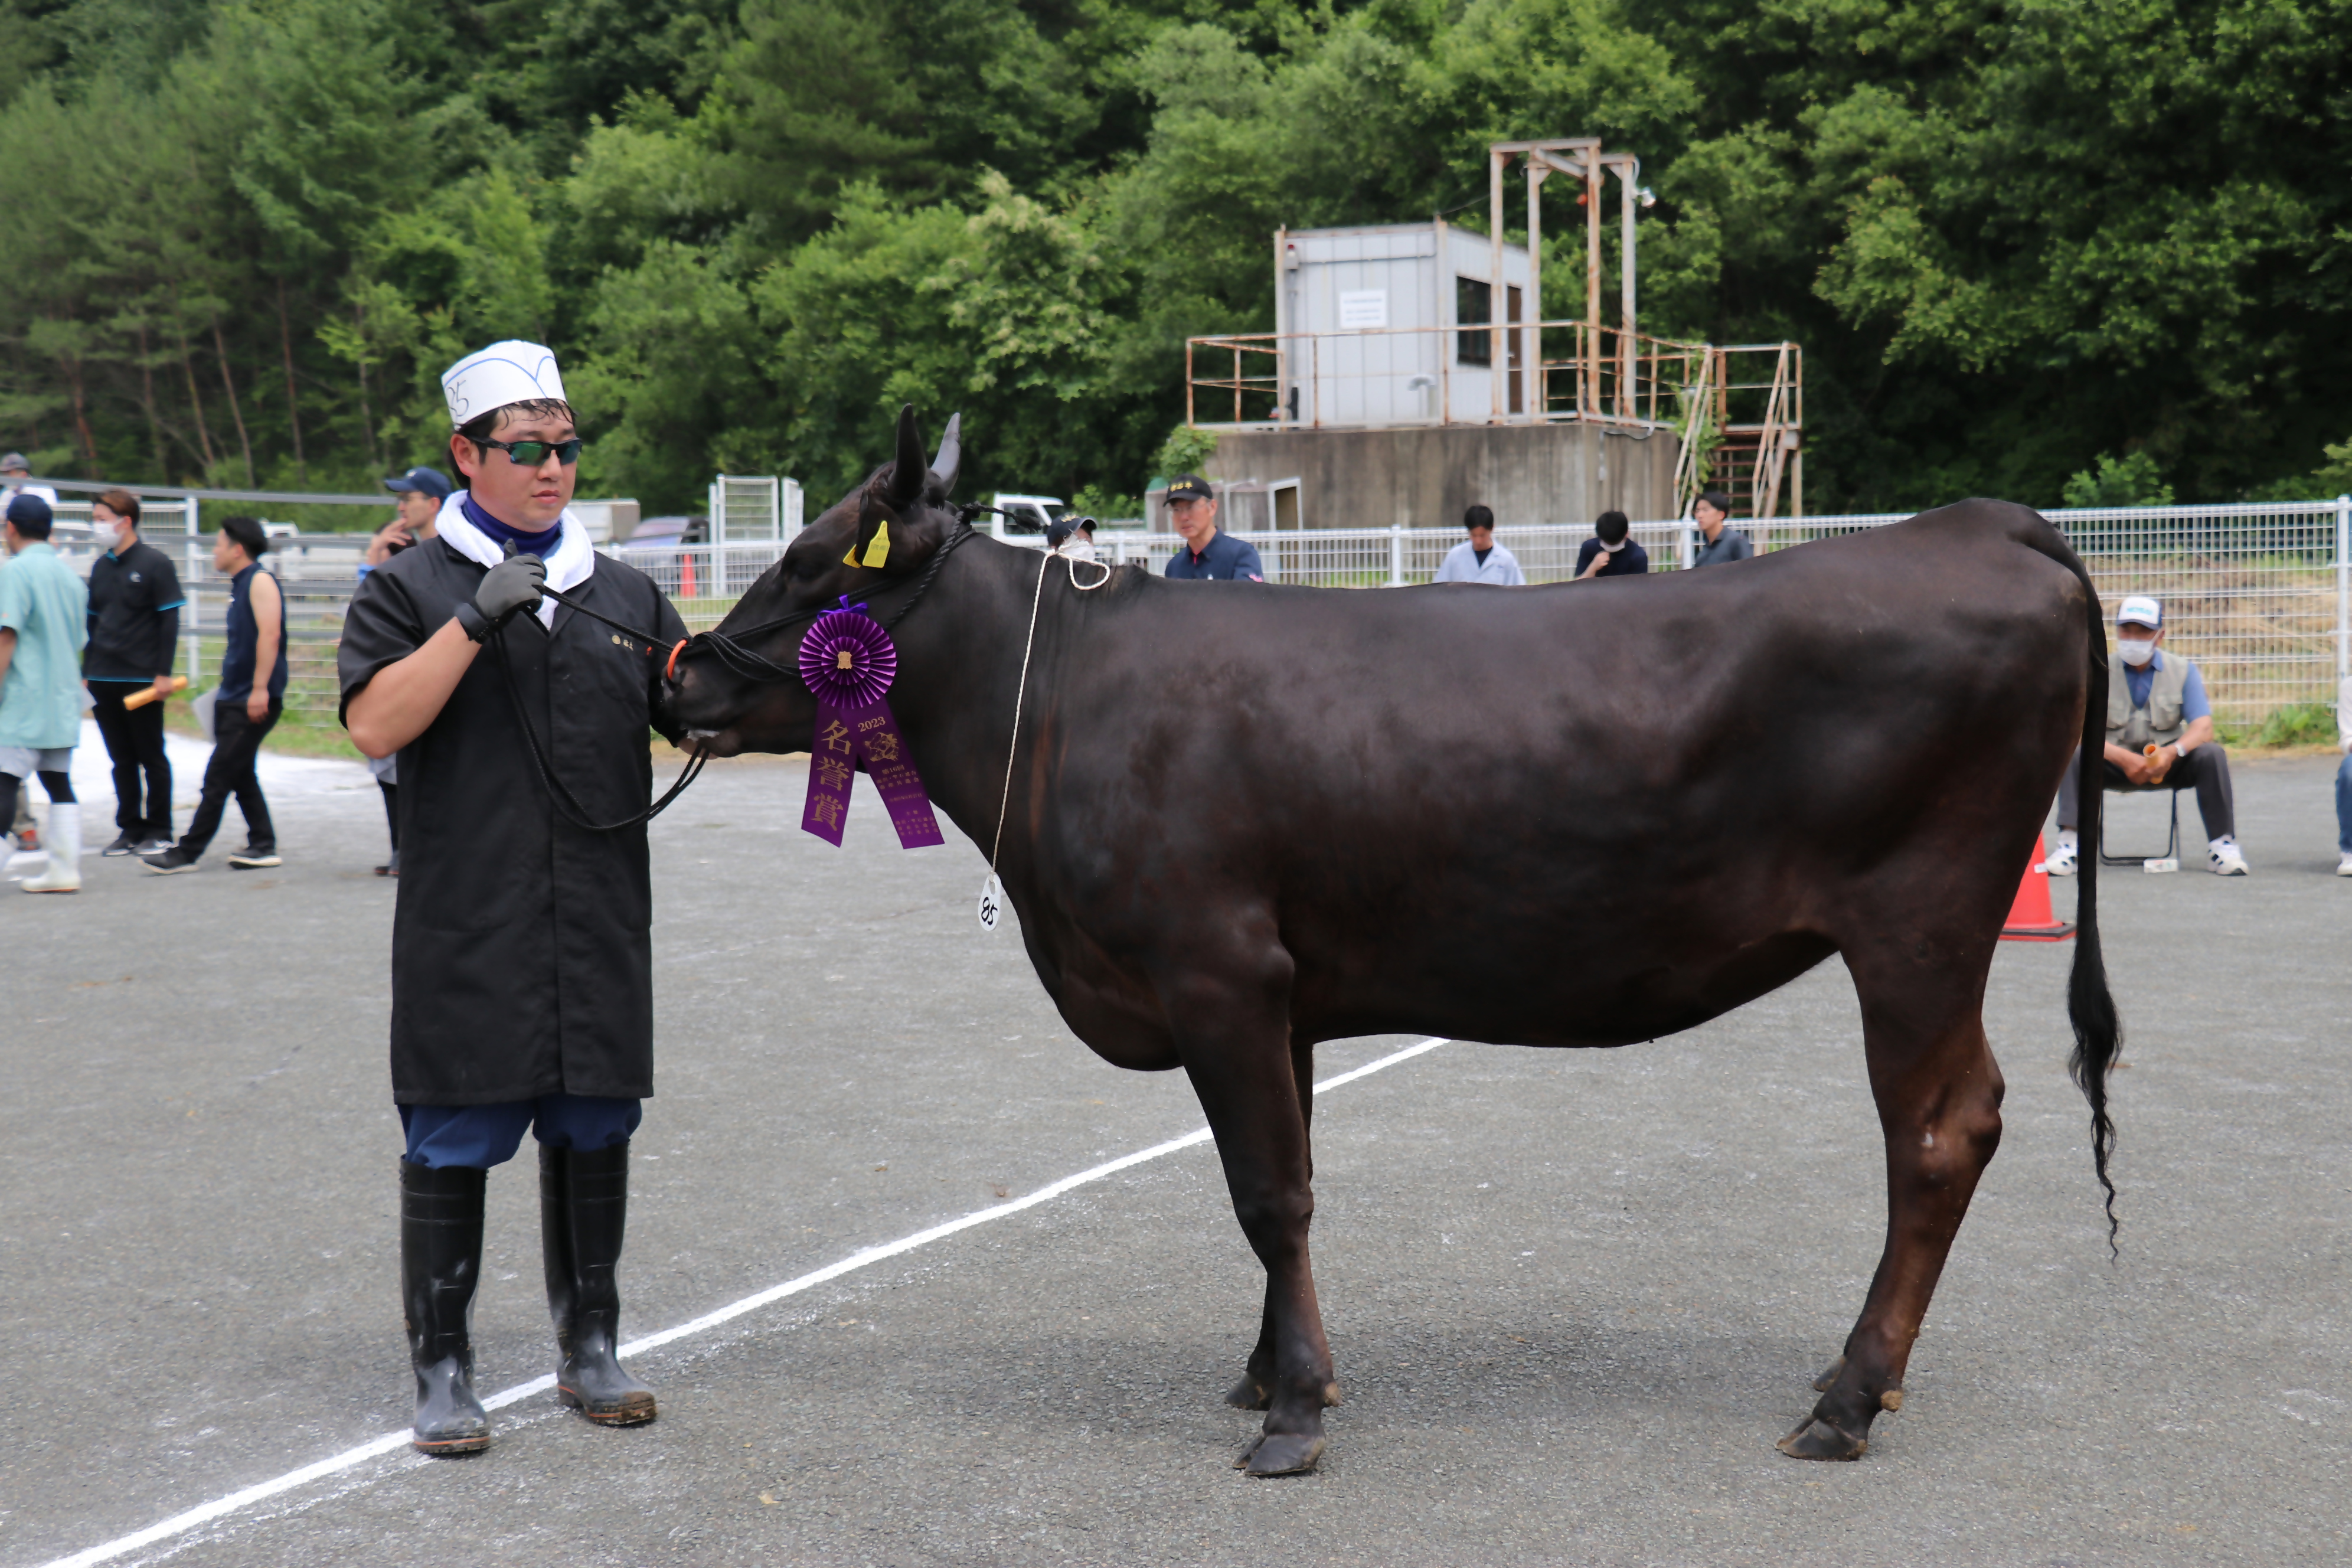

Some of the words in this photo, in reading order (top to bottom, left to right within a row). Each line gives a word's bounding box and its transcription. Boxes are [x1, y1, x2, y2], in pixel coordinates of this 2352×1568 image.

[858, 716, 886, 732] 2023
[811, 719, 852, 831] 名誉賞
[981, 896, 998, 926] 85
